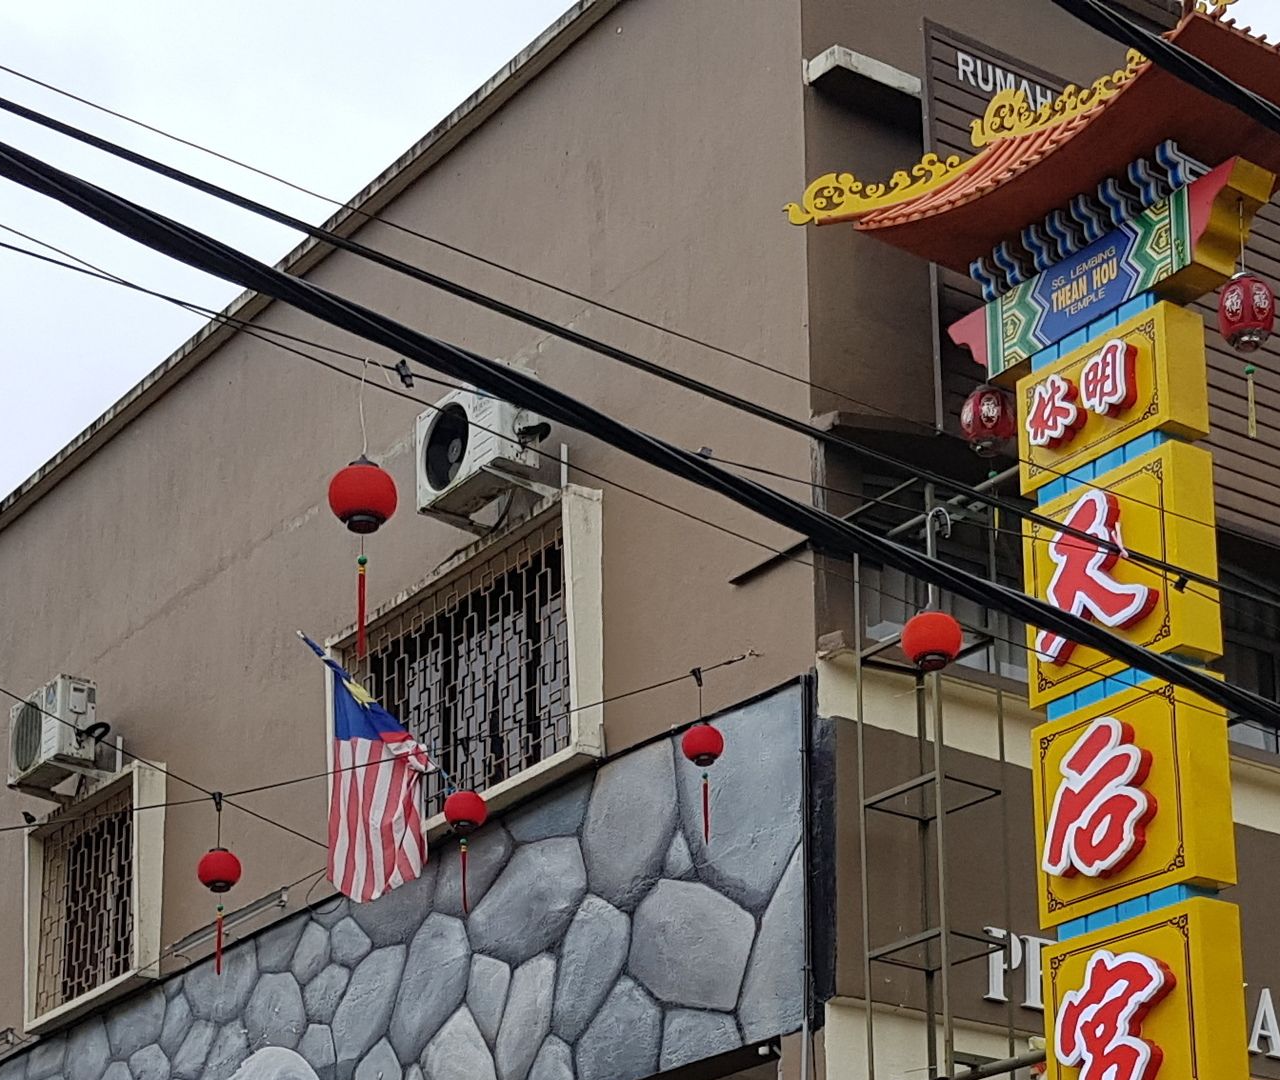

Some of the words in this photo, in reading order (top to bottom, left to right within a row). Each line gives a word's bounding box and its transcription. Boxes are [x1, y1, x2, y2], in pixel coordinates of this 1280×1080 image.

[1070, 246, 1116, 280] LEMBING
[1051, 275, 1087, 313] THEAN
[1092, 257, 1117, 290] HOU
[1064, 287, 1105, 318] TEMPLE
